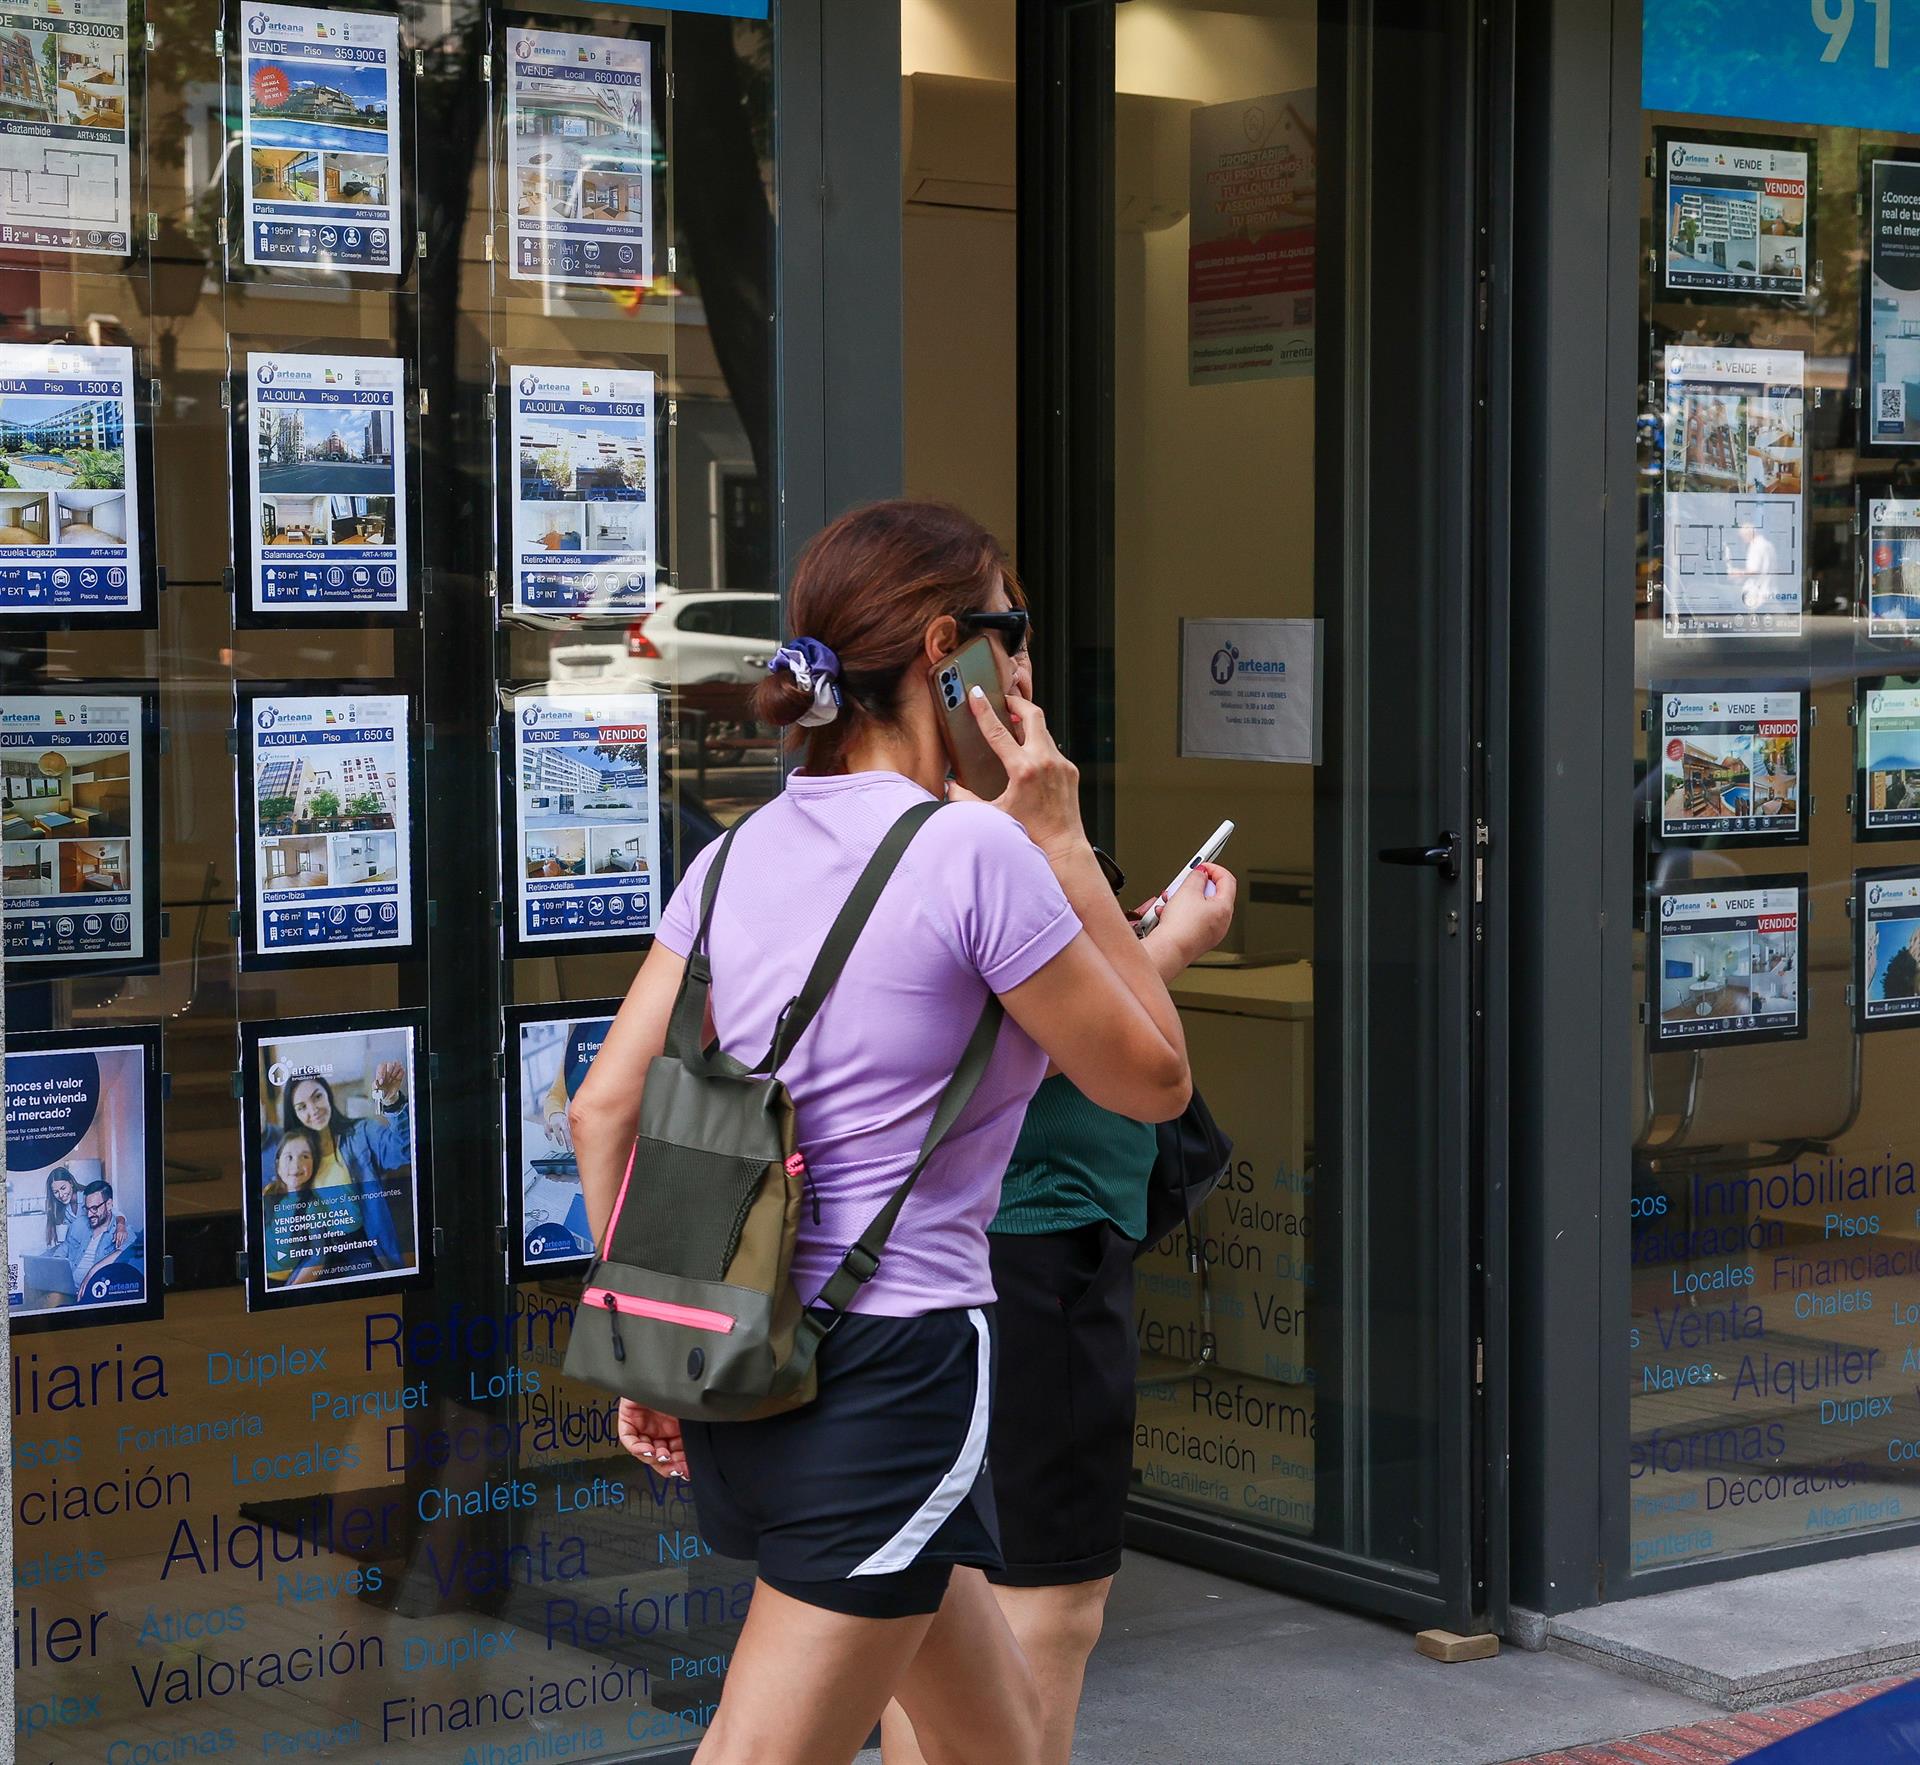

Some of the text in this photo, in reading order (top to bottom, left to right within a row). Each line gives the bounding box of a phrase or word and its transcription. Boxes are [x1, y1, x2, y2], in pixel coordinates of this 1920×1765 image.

[32, 18, 120, 38] Piso 539.000€
[268, 22, 304, 33] arteana
[1811, 0, 1890, 68] 91
[251, 41, 375, 61] VENDE Piso 359.900
[534, 47, 566, 57] arteana
[521, 65, 632, 84] VENDE Local 660.000
[6, 124, 52, 138] Gaztambide
[1733, 158, 1762, 170] VENDE
[1764, 181, 1805, 197] VENDIDO
[255, 205, 275, 214] Parla
[1881, 208, 1910, 220] real de
[280, 244, 296, 253] EXT
[276, 370, 312, 380] arteana
[1726, 362, 1757, 375] VENDE
[44, 382, 120, 394] Piso 1.500 €
[538, 382, 570, 392] arteana
[262, 391, 390, 403] ALQUILA Piso 1.200 €
[525, 402, 633, 415] ALQUILA Piso 1.650
[264, 551, 325, 561] Salamanca-Goya
[523, 555, 560, 564] Retiro-Niño
[1238, 658, 1286, 673] arteana
[541, 711, 572, 720] arteana
[1727, 704, 1756, 715] VENDE
[2, 713, 40, 722] arteana
[277, 713, 312, 722] arteana
[264, 728, 392, 745] ALQUILA Piso 1.650 €
[528, 728, 647, 742] VENDE Piso VENDIDO
[1758, 723, 1798, 736] VENDIDO
[51, 734, 71, 744] Piso
[87, 732, 117, 745] 1.200
[119, 732, 127, 743] €
[528, 882, 574, 892] Retiro-Adelfas
[264, 892, 305, 902] Retiro-Ibiza
[1725, 899, 1754, 911] VENDE
[1757, 917, 1797, 930] VENDIDO
[577, 1042, 586, 1052] El
[291, 1063, 333, 1075] arteana
[44, 1079, 53, 1090] el
[56, 1077, 83, 1089] valor
[13, 1091, 87, 1107] de tu vivienda
[6, 1107, 71, 1122] el mercado?
[1692, 1152, 1916, 1220] Inmobiliaria
[274, 1209, 349, 1226] VENDEMOS TU CASA
[274, 1217, 356, 1235] SIN COMPLICACIONES.
[1824, 1213, 1880, 1240] Pisos
[275, 1229, 346, 1246] Tenemos una oferta.
[289, 1239, 378, 1260] Entra y pregúntanos
[311, 1261, 372, 1277] www.arteana.com
[1672, 1264, 1755, 1296] Locales
[1654, 1289, 1873, 1352] Venta Chalets
[14, 1342, 168, 1416] liaria
[207, 1344, 328, 1388] Dúplex
[1643, 1343, 1880, 1405] Naves Alquiler
[311, 1366, 541, 1422] Parquet Lofts
[1820, 1394, 1895, 1426] Dúplex
[116, 1412, 264, 1454] Fontanería
[231, 1439, 362, 1487] Locales
[1135, 1422, 1256, 1474] anciación
[20, 1465, 626, 1582] ciación Alquiler Chalets Lofts
[14, 1549, 107, 1589] alets
[275, 1566, 384, 1608] Naves
[424, 1529, 590, 1600] Venta
[131, 1629, 384, 1708] Valoración
[383, 1661, 648, 1743] Financiación
[106, 1725, 240, 1765] Cocinas
